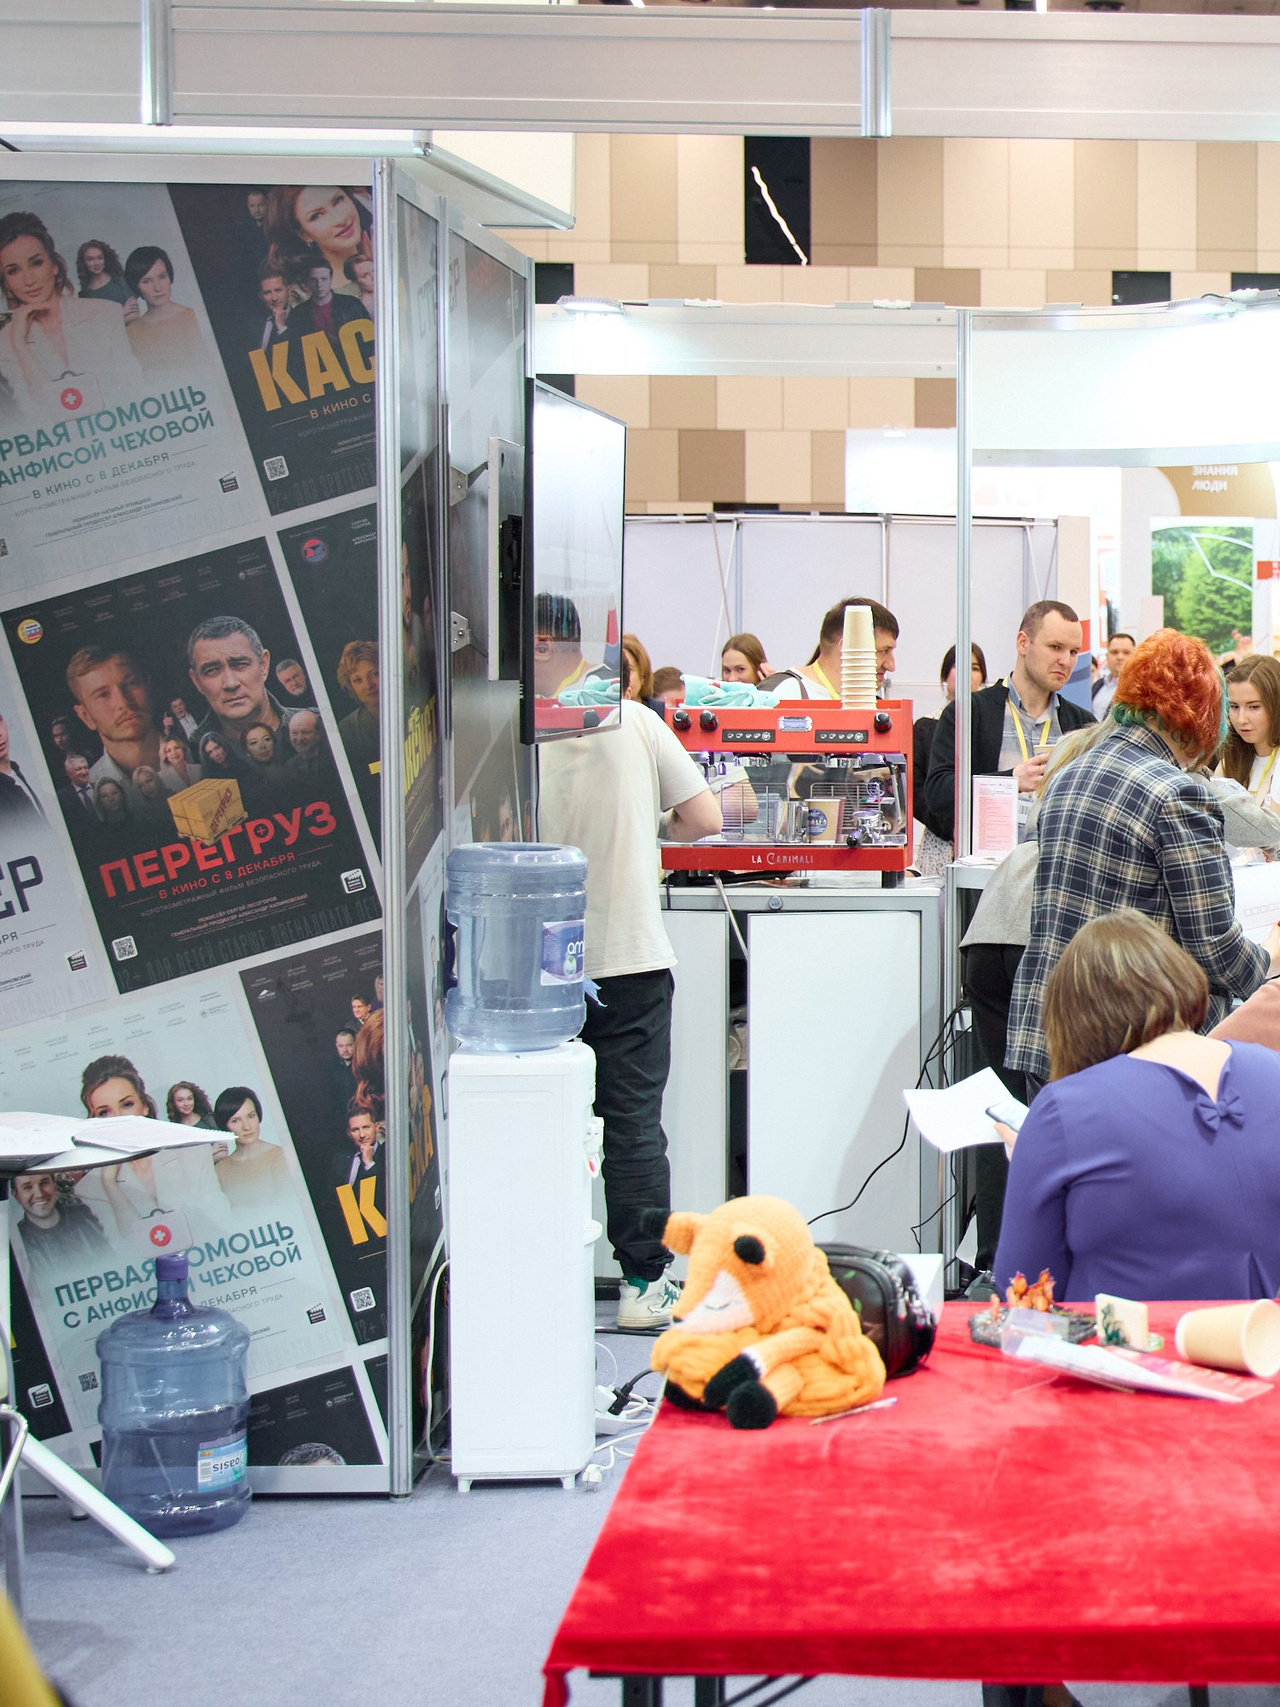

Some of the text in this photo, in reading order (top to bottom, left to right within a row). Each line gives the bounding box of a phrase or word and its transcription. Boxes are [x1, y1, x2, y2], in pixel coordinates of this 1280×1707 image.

[248, 318, 376, 412] КАС
[75, 385, 206, 438] ПОМОЩЬ
[322, 397, 359, 415] КИНО
[363, 393, 372, 403] С
[0, 408, 215, 487] АНФИСОЙ ЧЕХОВОЙ
[46, 478, 81, 496] КИНО
[86, 474, 95, 483] С
[112, 452, 170, 478] ДЕКАБРЯ
[1191, 480, 1227, 493] ЛЮДИ
[100, 801, 337, 898] ПЕРЕГРУЗ
[751, 855, 762, 863] LA
[172, 877, 207, 895] КИНО
[212, 874, 221, 884] С
[225, 870, 233, 880] 8
[238, 852, 295, 878] ДЕКАБРЯ
[299, 859, 321, 871] ТРУДА
[0, 932, 18, 945] РЯ
[22, 940, 45, 950] ТРУДА
[54, 1221, 294, 1307] ПЕРВАЯ ОМОЩЬ
[63, 1310, 81, 1328] С
[199, 1242, 302, 1288] ЧЕХОВОЙ
[201, 1286, 258, 1308] ДЕКАБРЯ
[262, 1293, 284, 1304] ТРУДА
[213, 1457, 240, 1474] oasis
